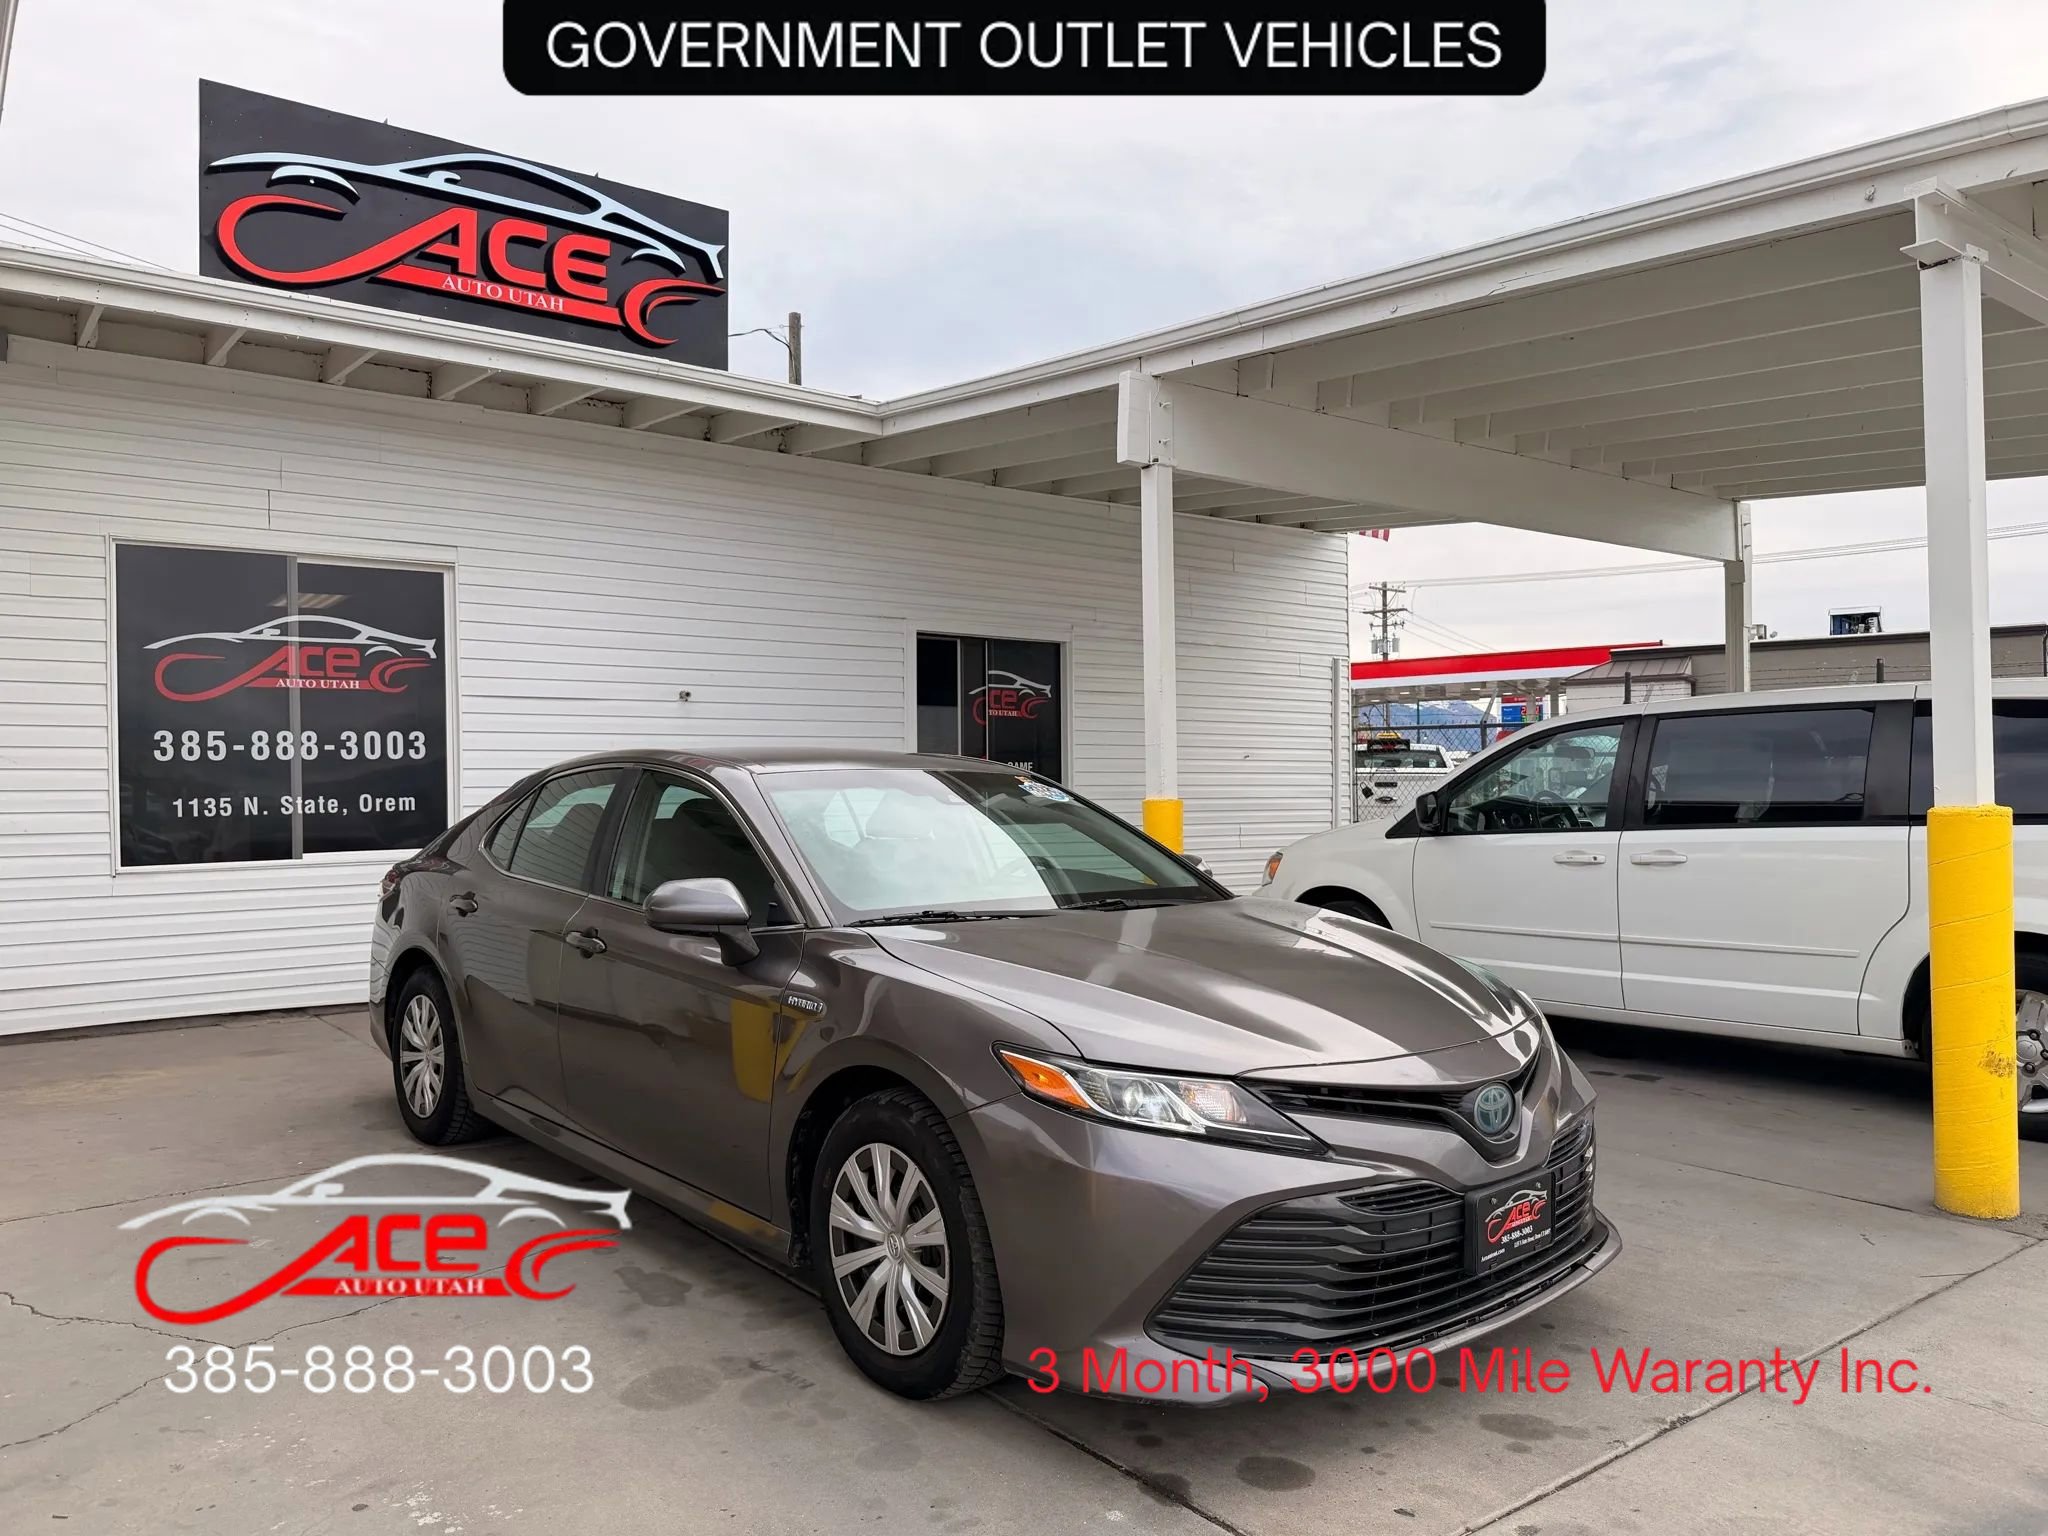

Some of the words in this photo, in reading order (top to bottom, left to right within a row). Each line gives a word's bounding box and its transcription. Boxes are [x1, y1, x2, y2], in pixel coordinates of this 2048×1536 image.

[441, 273, 504, 300] AUTO
[508, 288, 565, 313] UTAH
[275, 677, 318, 690] AUTO
[319, 678, 361, 690] UTAH
[152, 729, 427, 762] 385-888-3003
[172, 797, 233, 818] 1135
[243, 796, 269, 816] N.
[280, 795, 349, 817] State,
[359, 792, 416, 813] Orem
